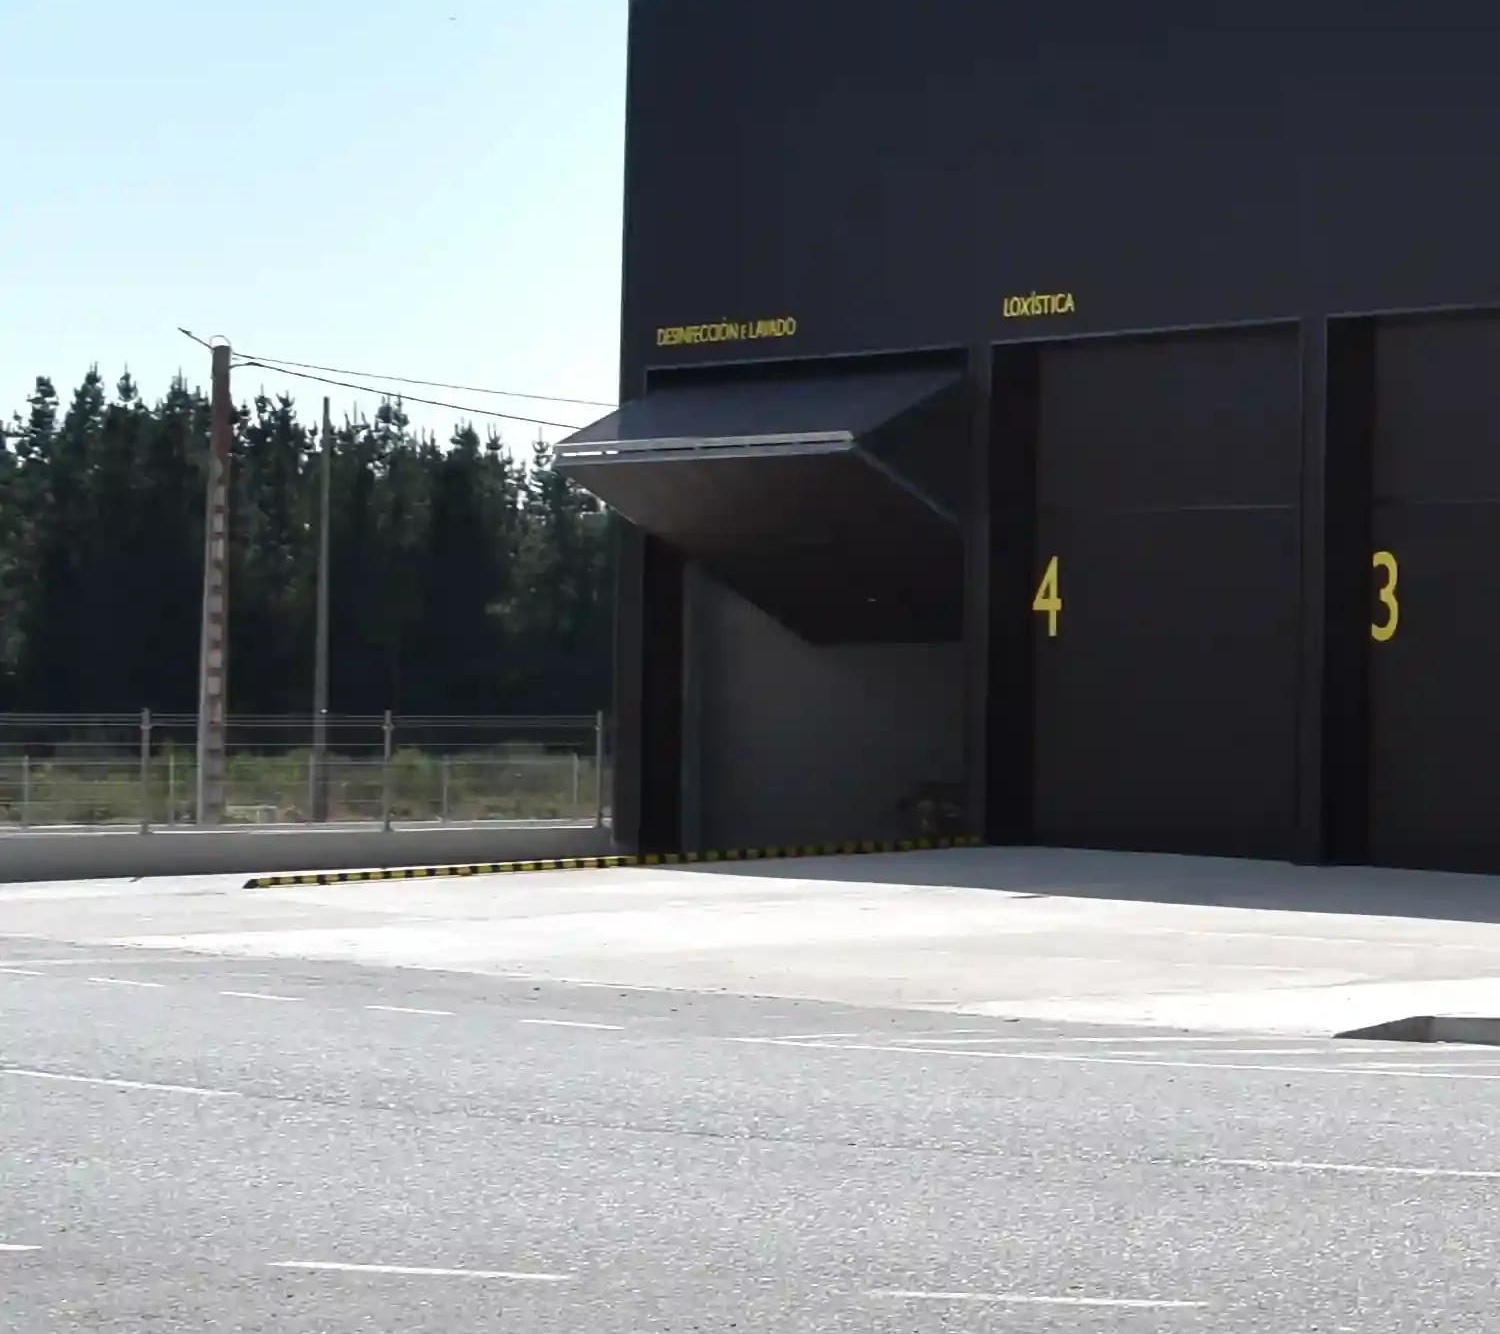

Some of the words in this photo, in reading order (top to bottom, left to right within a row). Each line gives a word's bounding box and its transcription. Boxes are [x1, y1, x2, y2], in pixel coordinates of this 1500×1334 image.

[748, 317, 797, 340] LAVADO
[1003, 290, 1076, 317] LOXÍSTICA
[1032, 556, 1063, 637] 4
[1371, 551, 1400, 642] 3
